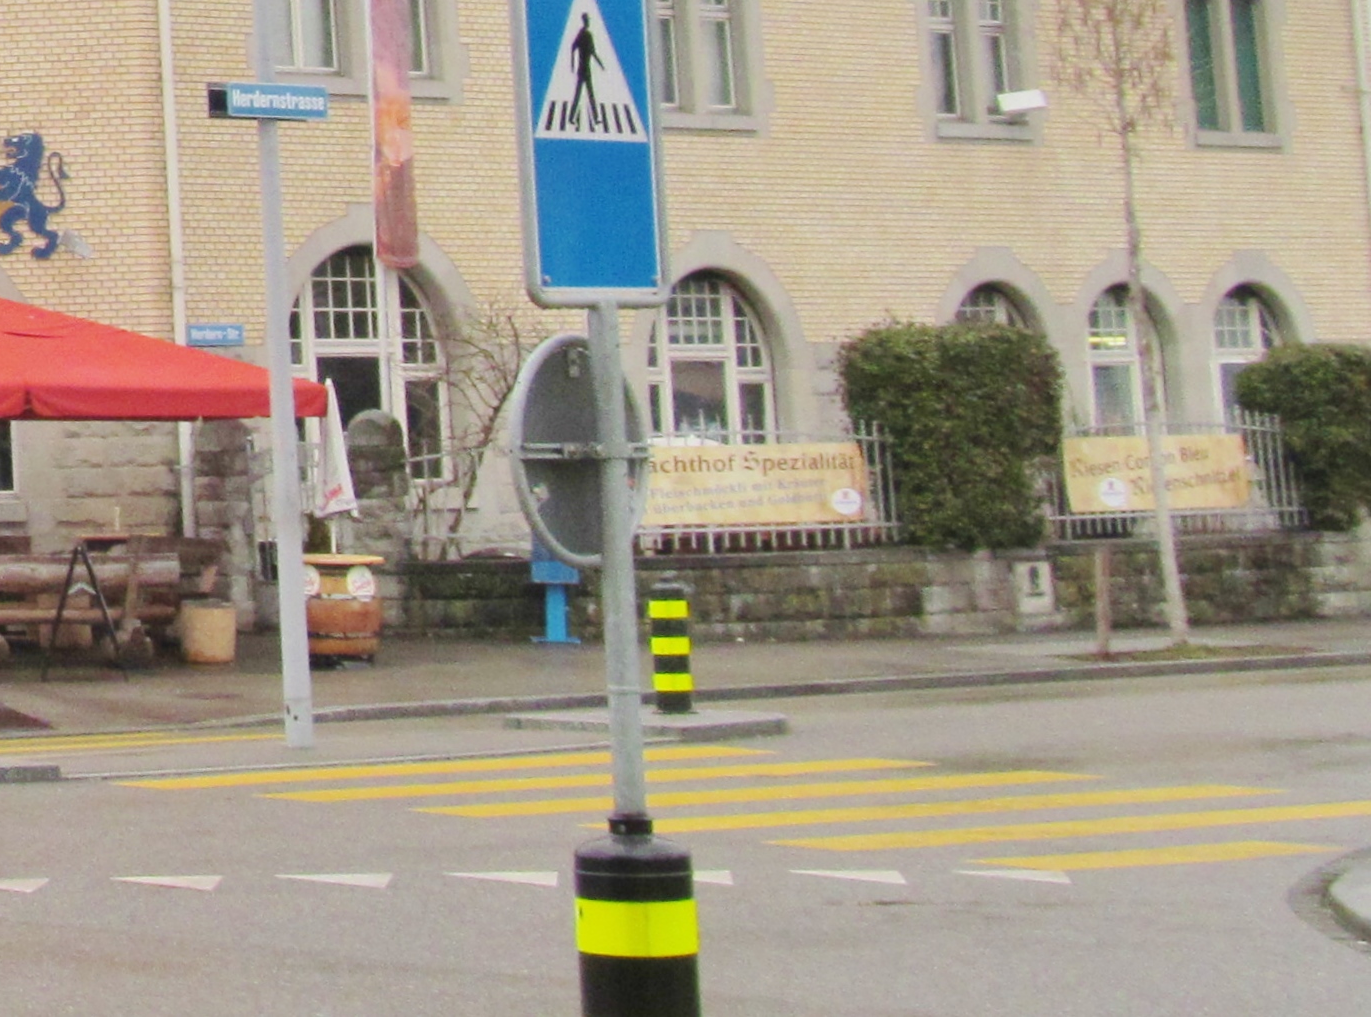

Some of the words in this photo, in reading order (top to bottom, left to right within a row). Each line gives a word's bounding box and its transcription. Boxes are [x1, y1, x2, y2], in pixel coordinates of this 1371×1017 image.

[231, 88, 325, 111] Herdernstrasse
[648, 453, 737, 475] achthof
[743, 450, 856, 476] Spezialität
